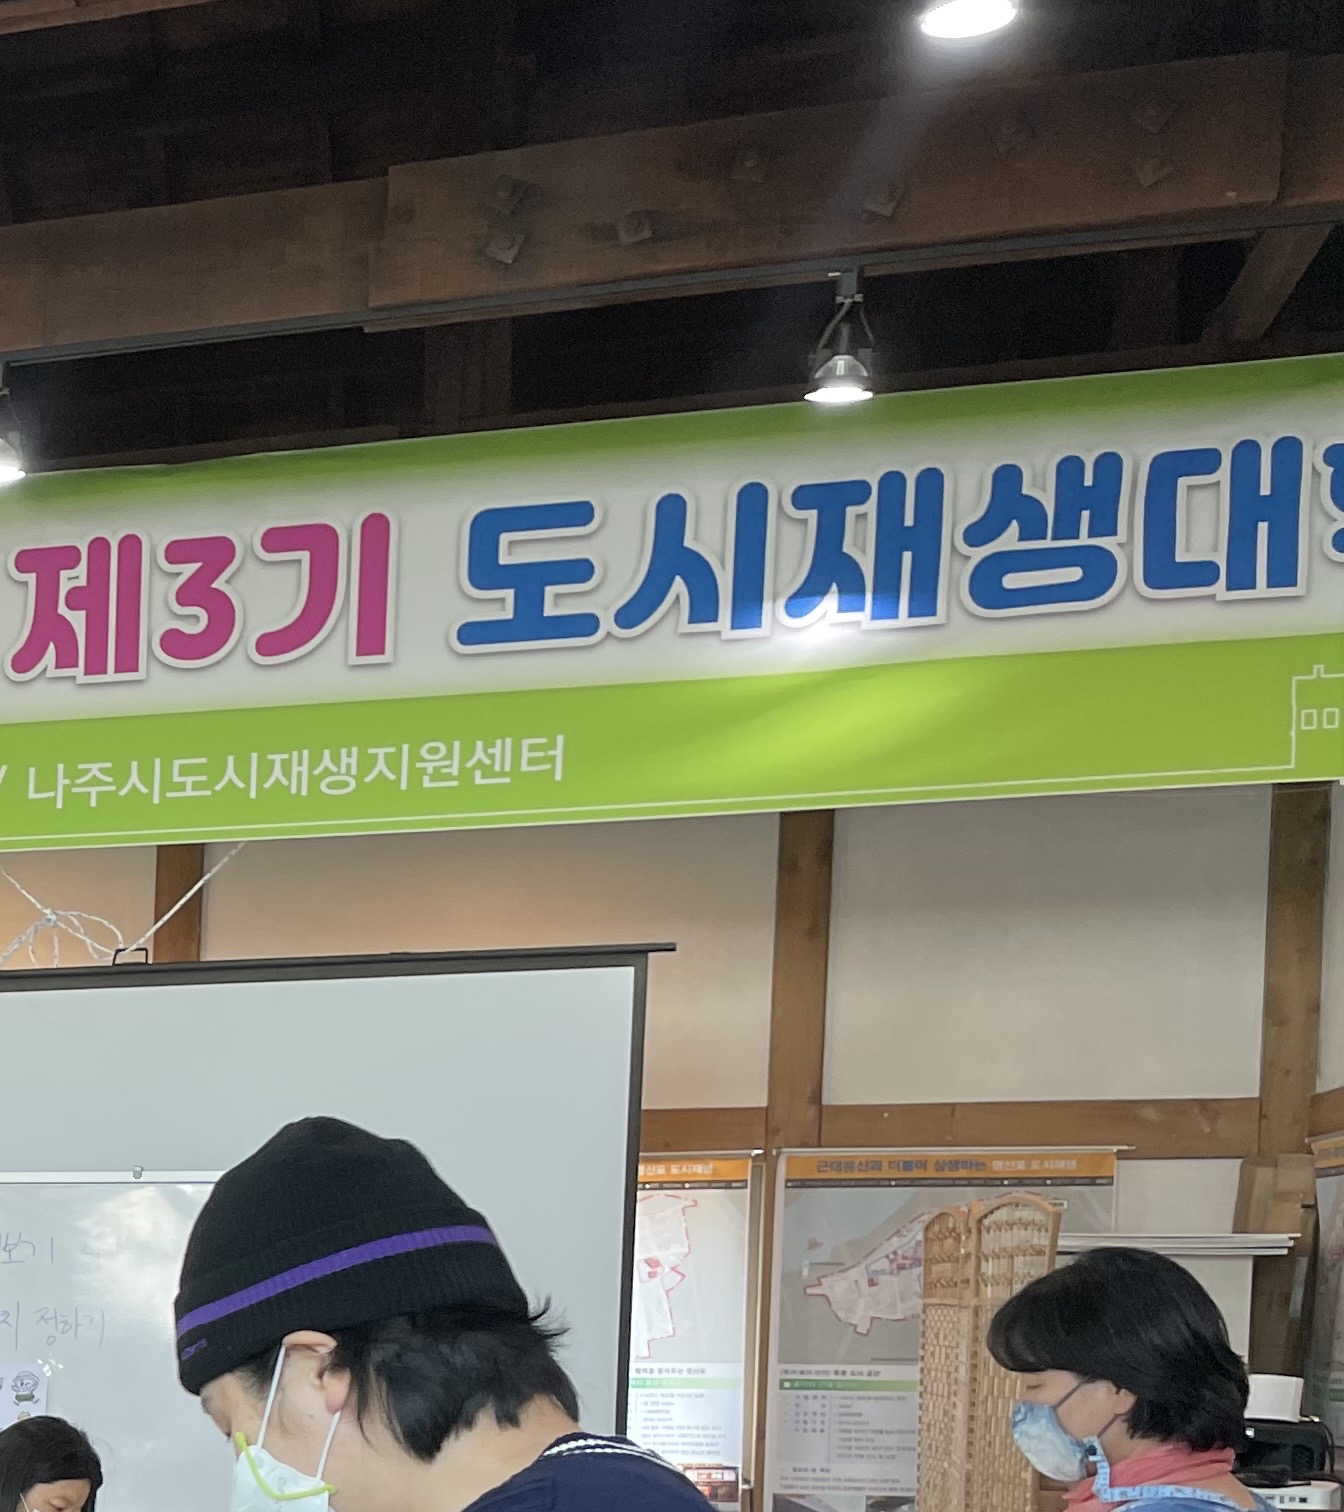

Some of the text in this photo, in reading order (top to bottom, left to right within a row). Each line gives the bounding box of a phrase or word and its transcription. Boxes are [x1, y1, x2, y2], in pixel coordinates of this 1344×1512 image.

[10, 511, 391, 679] 제3기
[455, 435, 1344, 648] 도시재생대
[26, 733, 565, 810] 나주시도시재생지원센터
